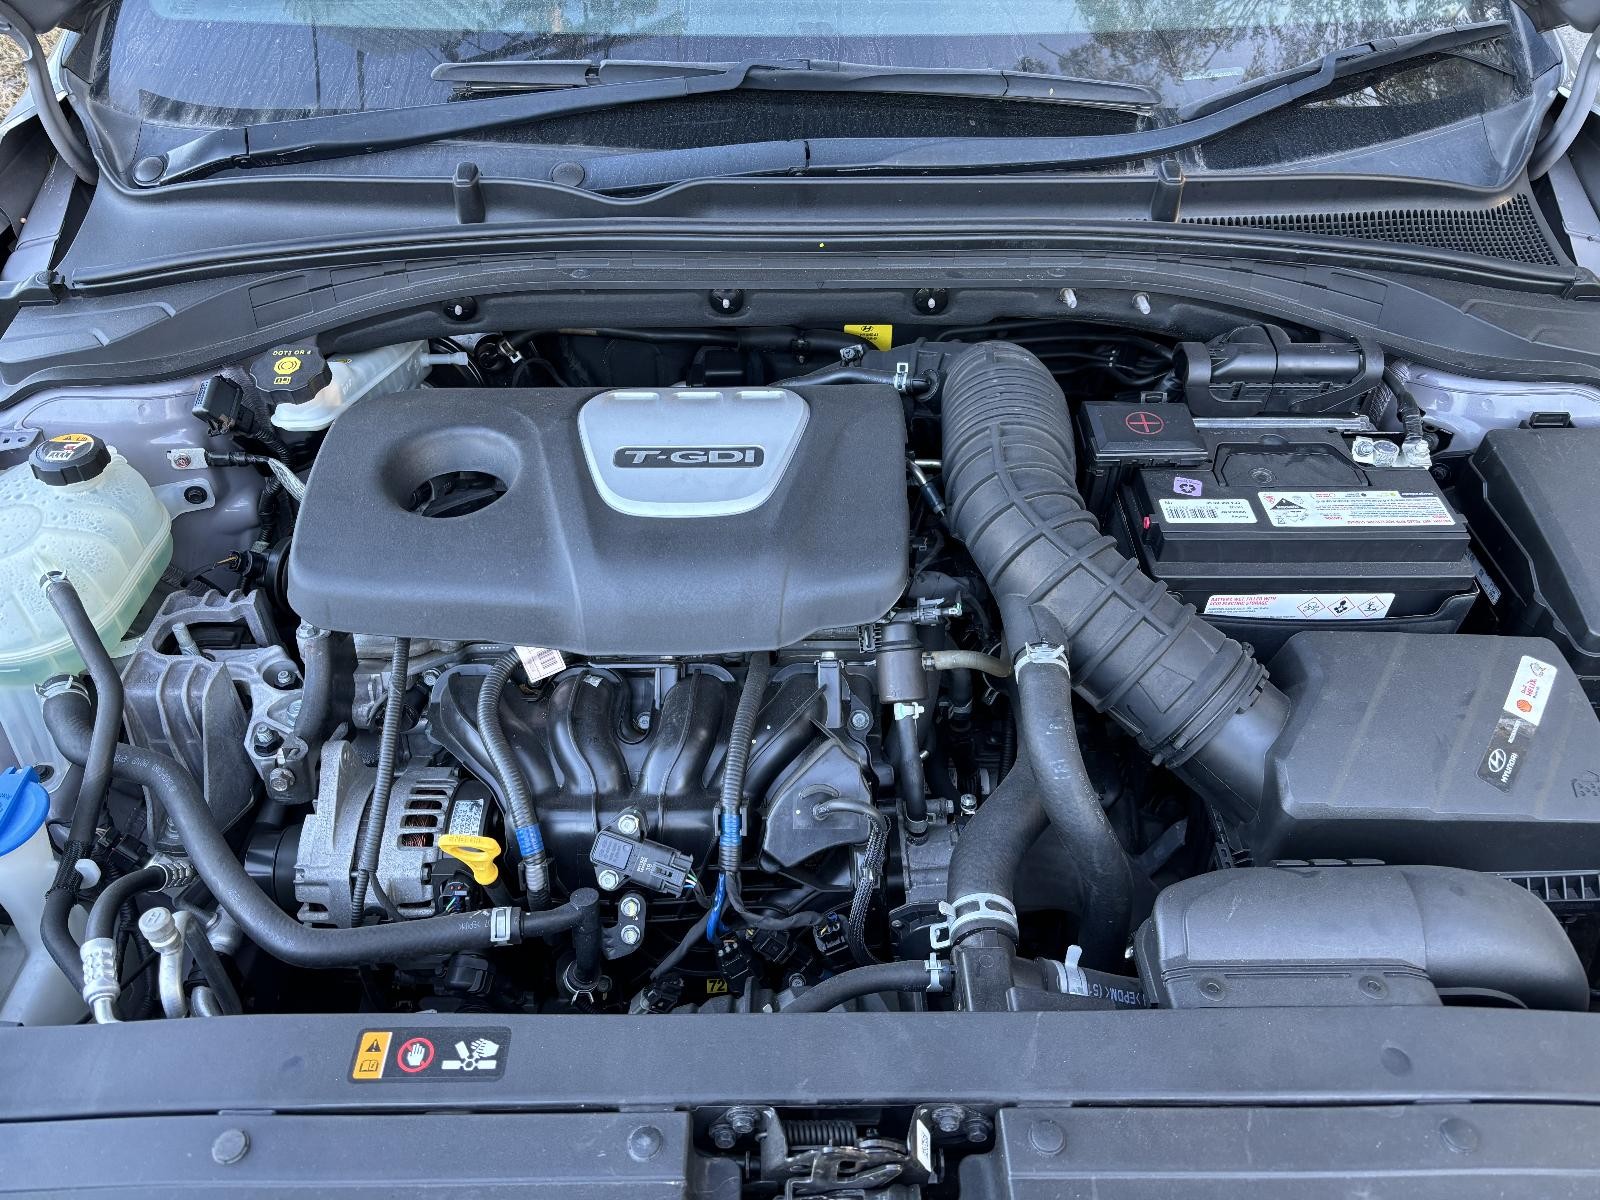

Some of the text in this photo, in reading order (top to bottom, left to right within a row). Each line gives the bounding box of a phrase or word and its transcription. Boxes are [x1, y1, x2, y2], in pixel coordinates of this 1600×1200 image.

[625, 450, 755, 464] T-GDI
[1501, 753, 1519, 783] HYUNDAI
[709, 979, 725, 992] 72
